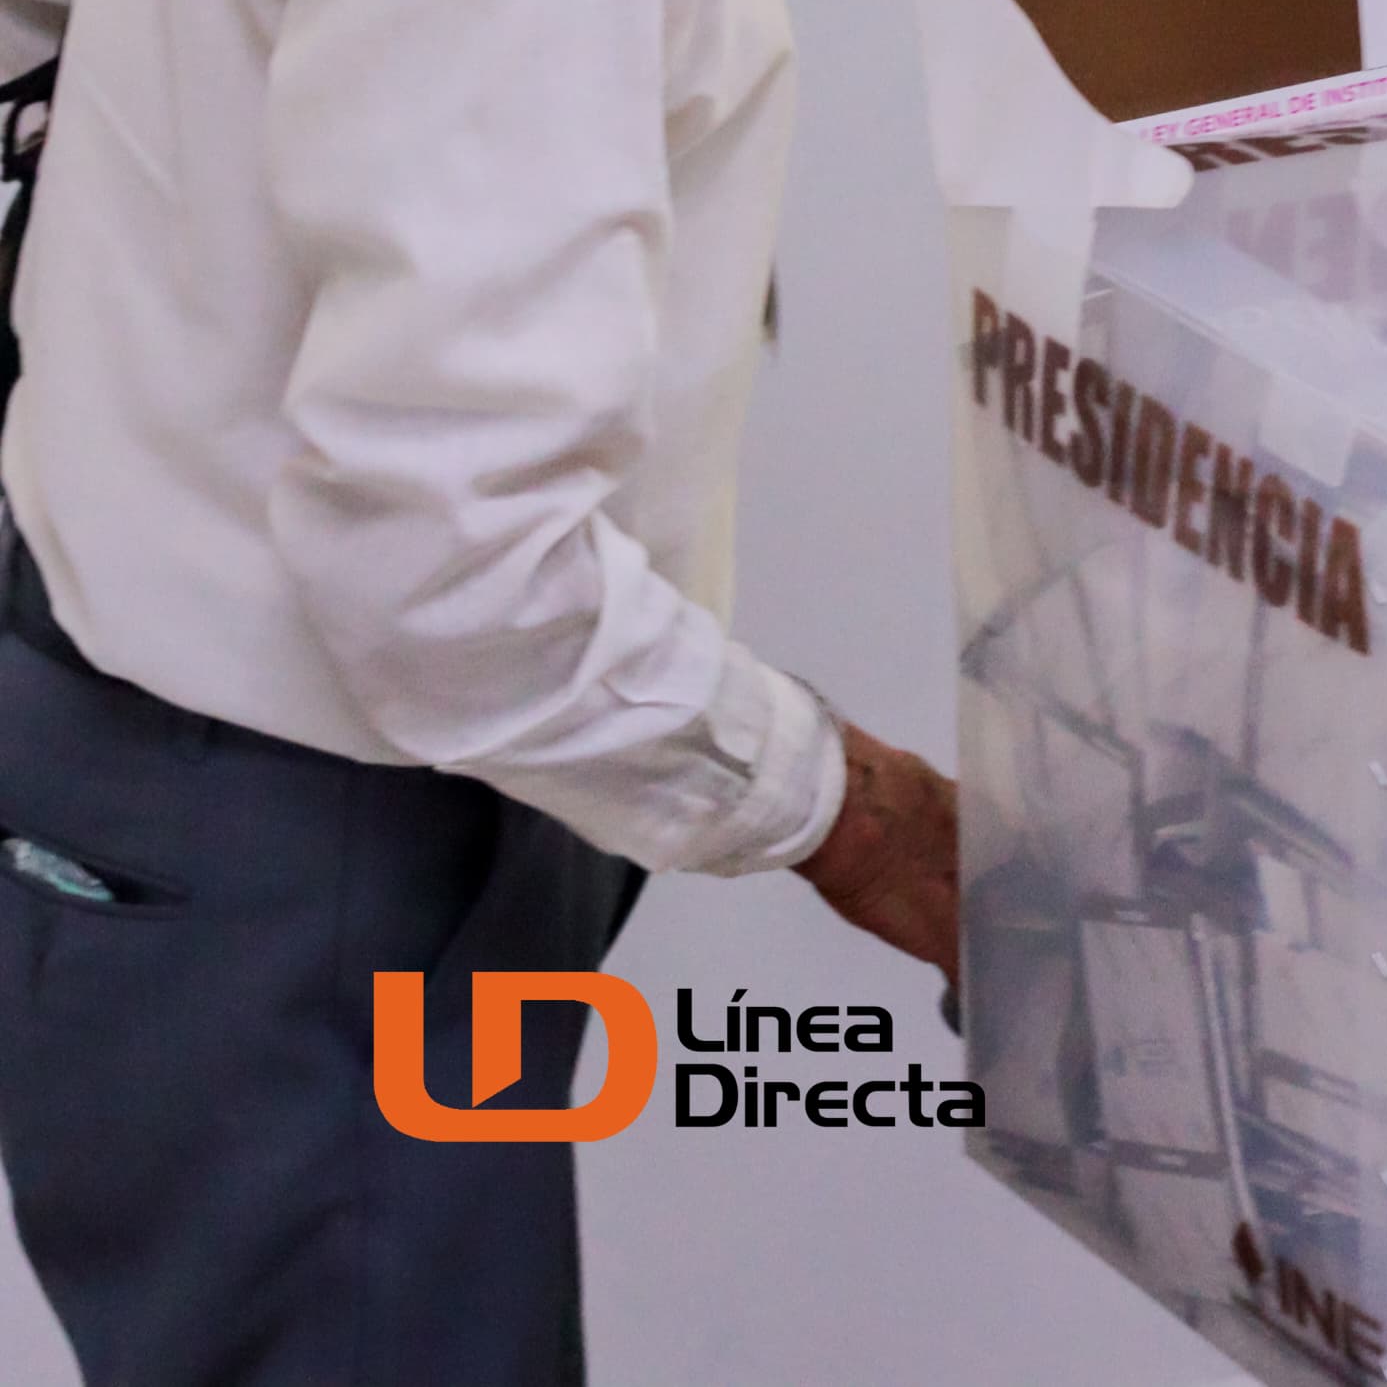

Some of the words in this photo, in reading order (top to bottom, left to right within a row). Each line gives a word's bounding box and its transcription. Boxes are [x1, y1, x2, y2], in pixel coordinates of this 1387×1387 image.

[1184, 101, 1282, 137] GENERAL
[1286, 90, 1317, 116] DE
[971, 286, 1370, 656] PRESIDENCIA
[1273, 1254, 1387, 1380] INE
